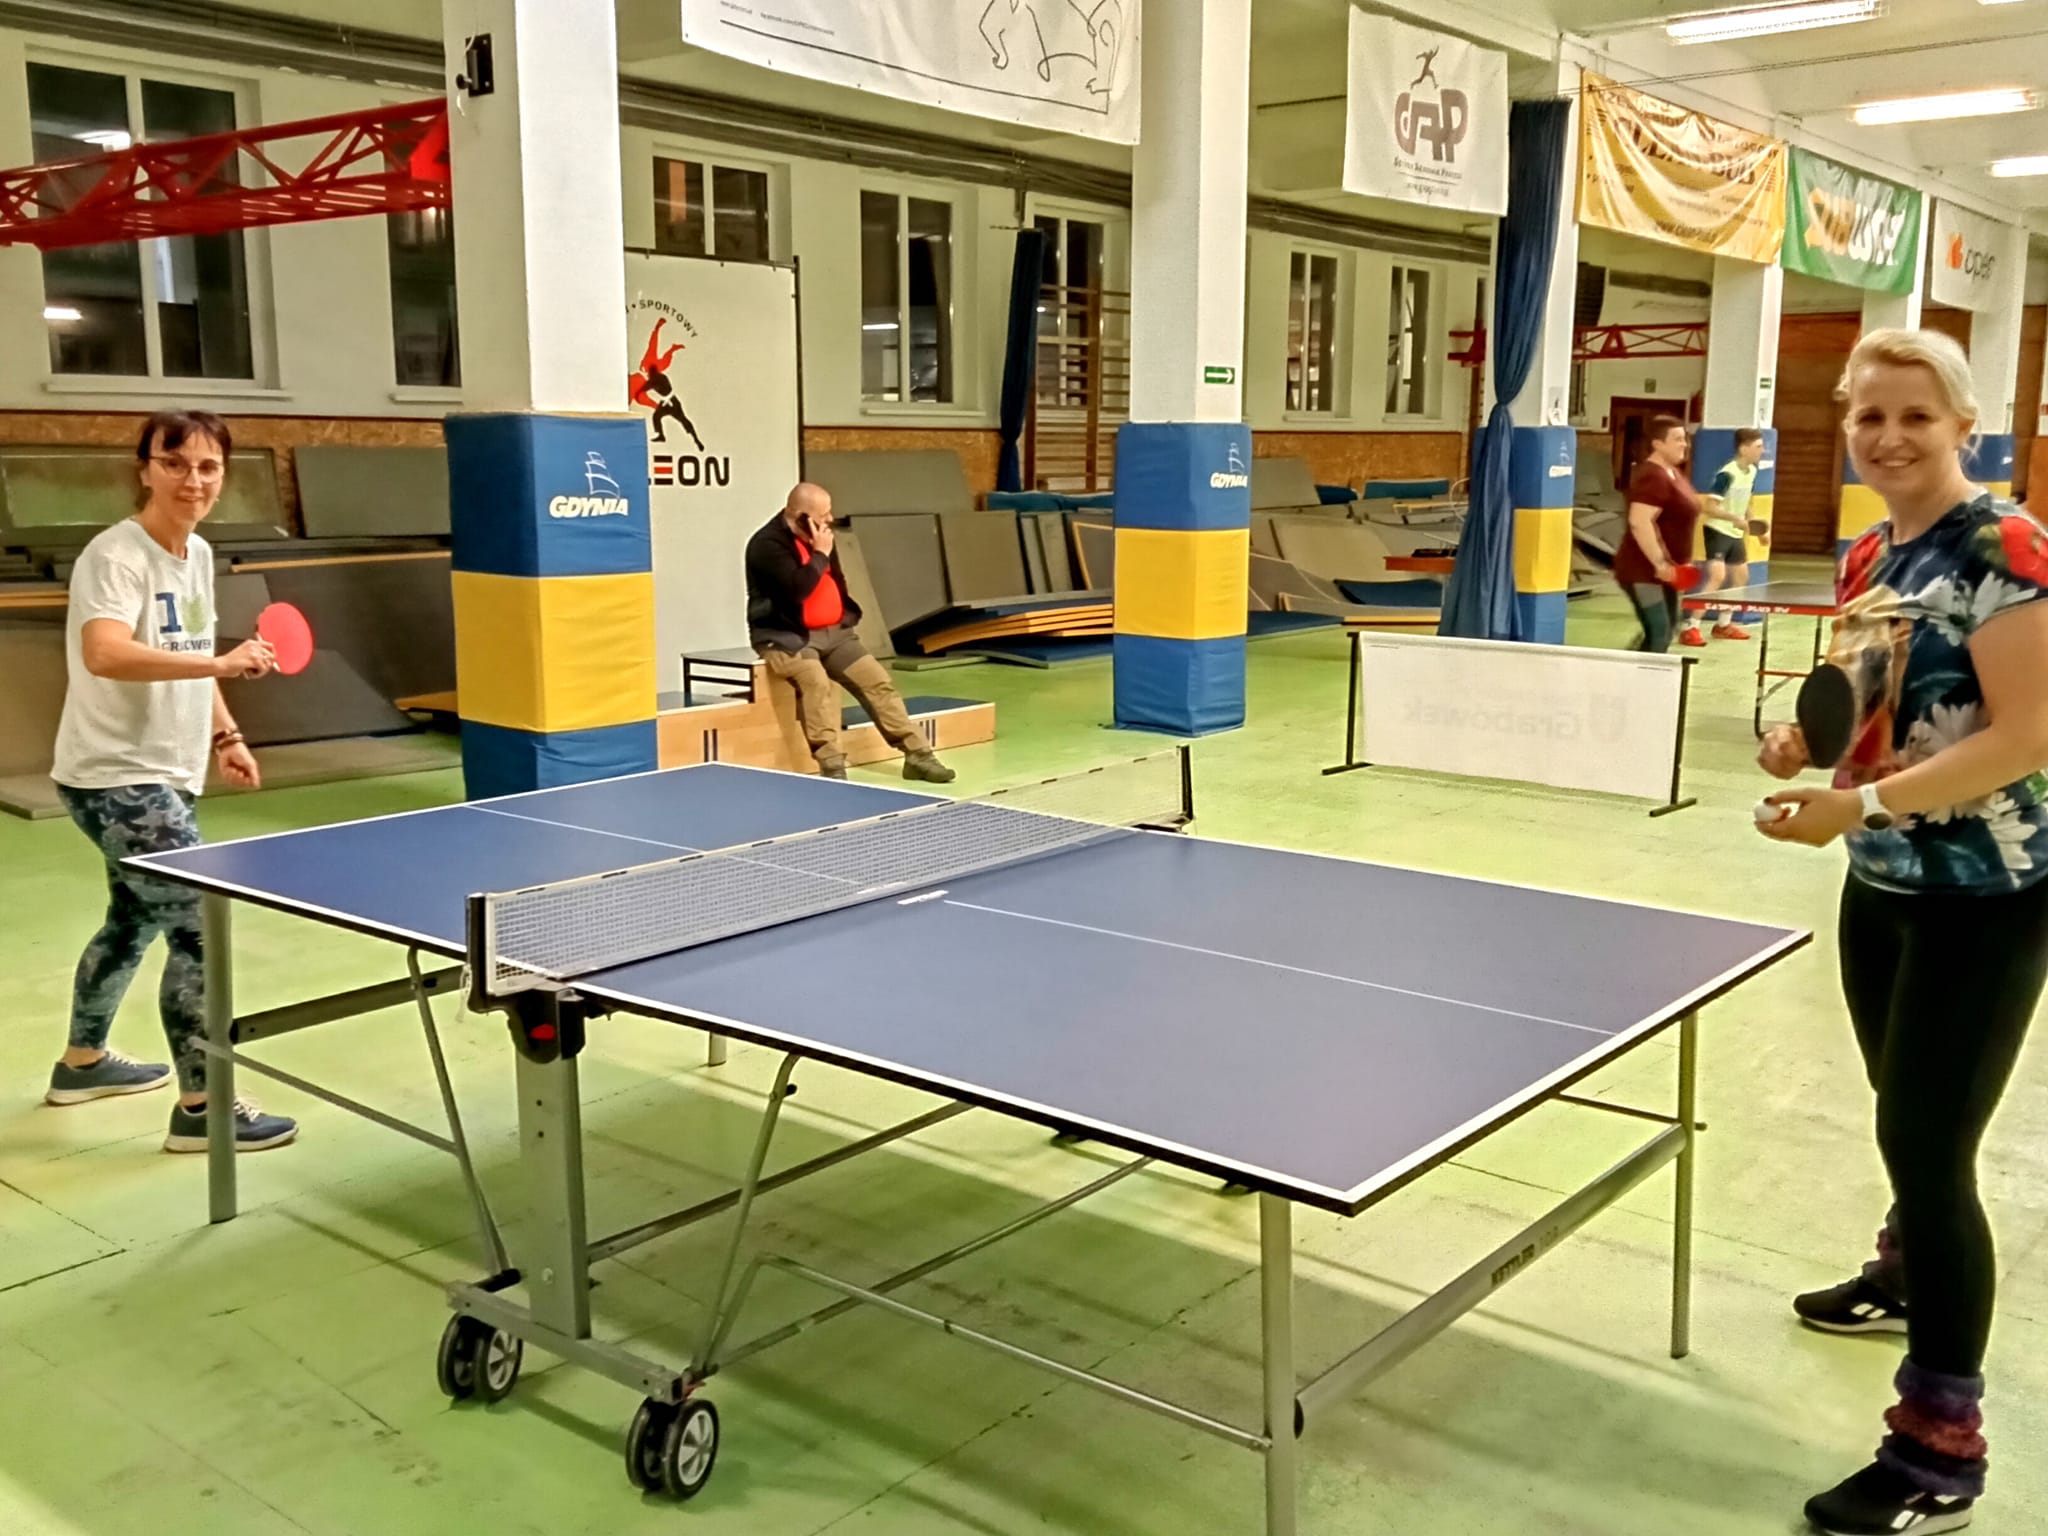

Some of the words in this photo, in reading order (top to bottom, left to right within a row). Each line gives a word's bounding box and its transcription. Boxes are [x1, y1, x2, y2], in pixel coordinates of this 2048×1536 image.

[639, 299, 698, 339] SPORTOWY
[648, 455, 730, 487] EON
[550, 495, 629, 518] GDYNIA
